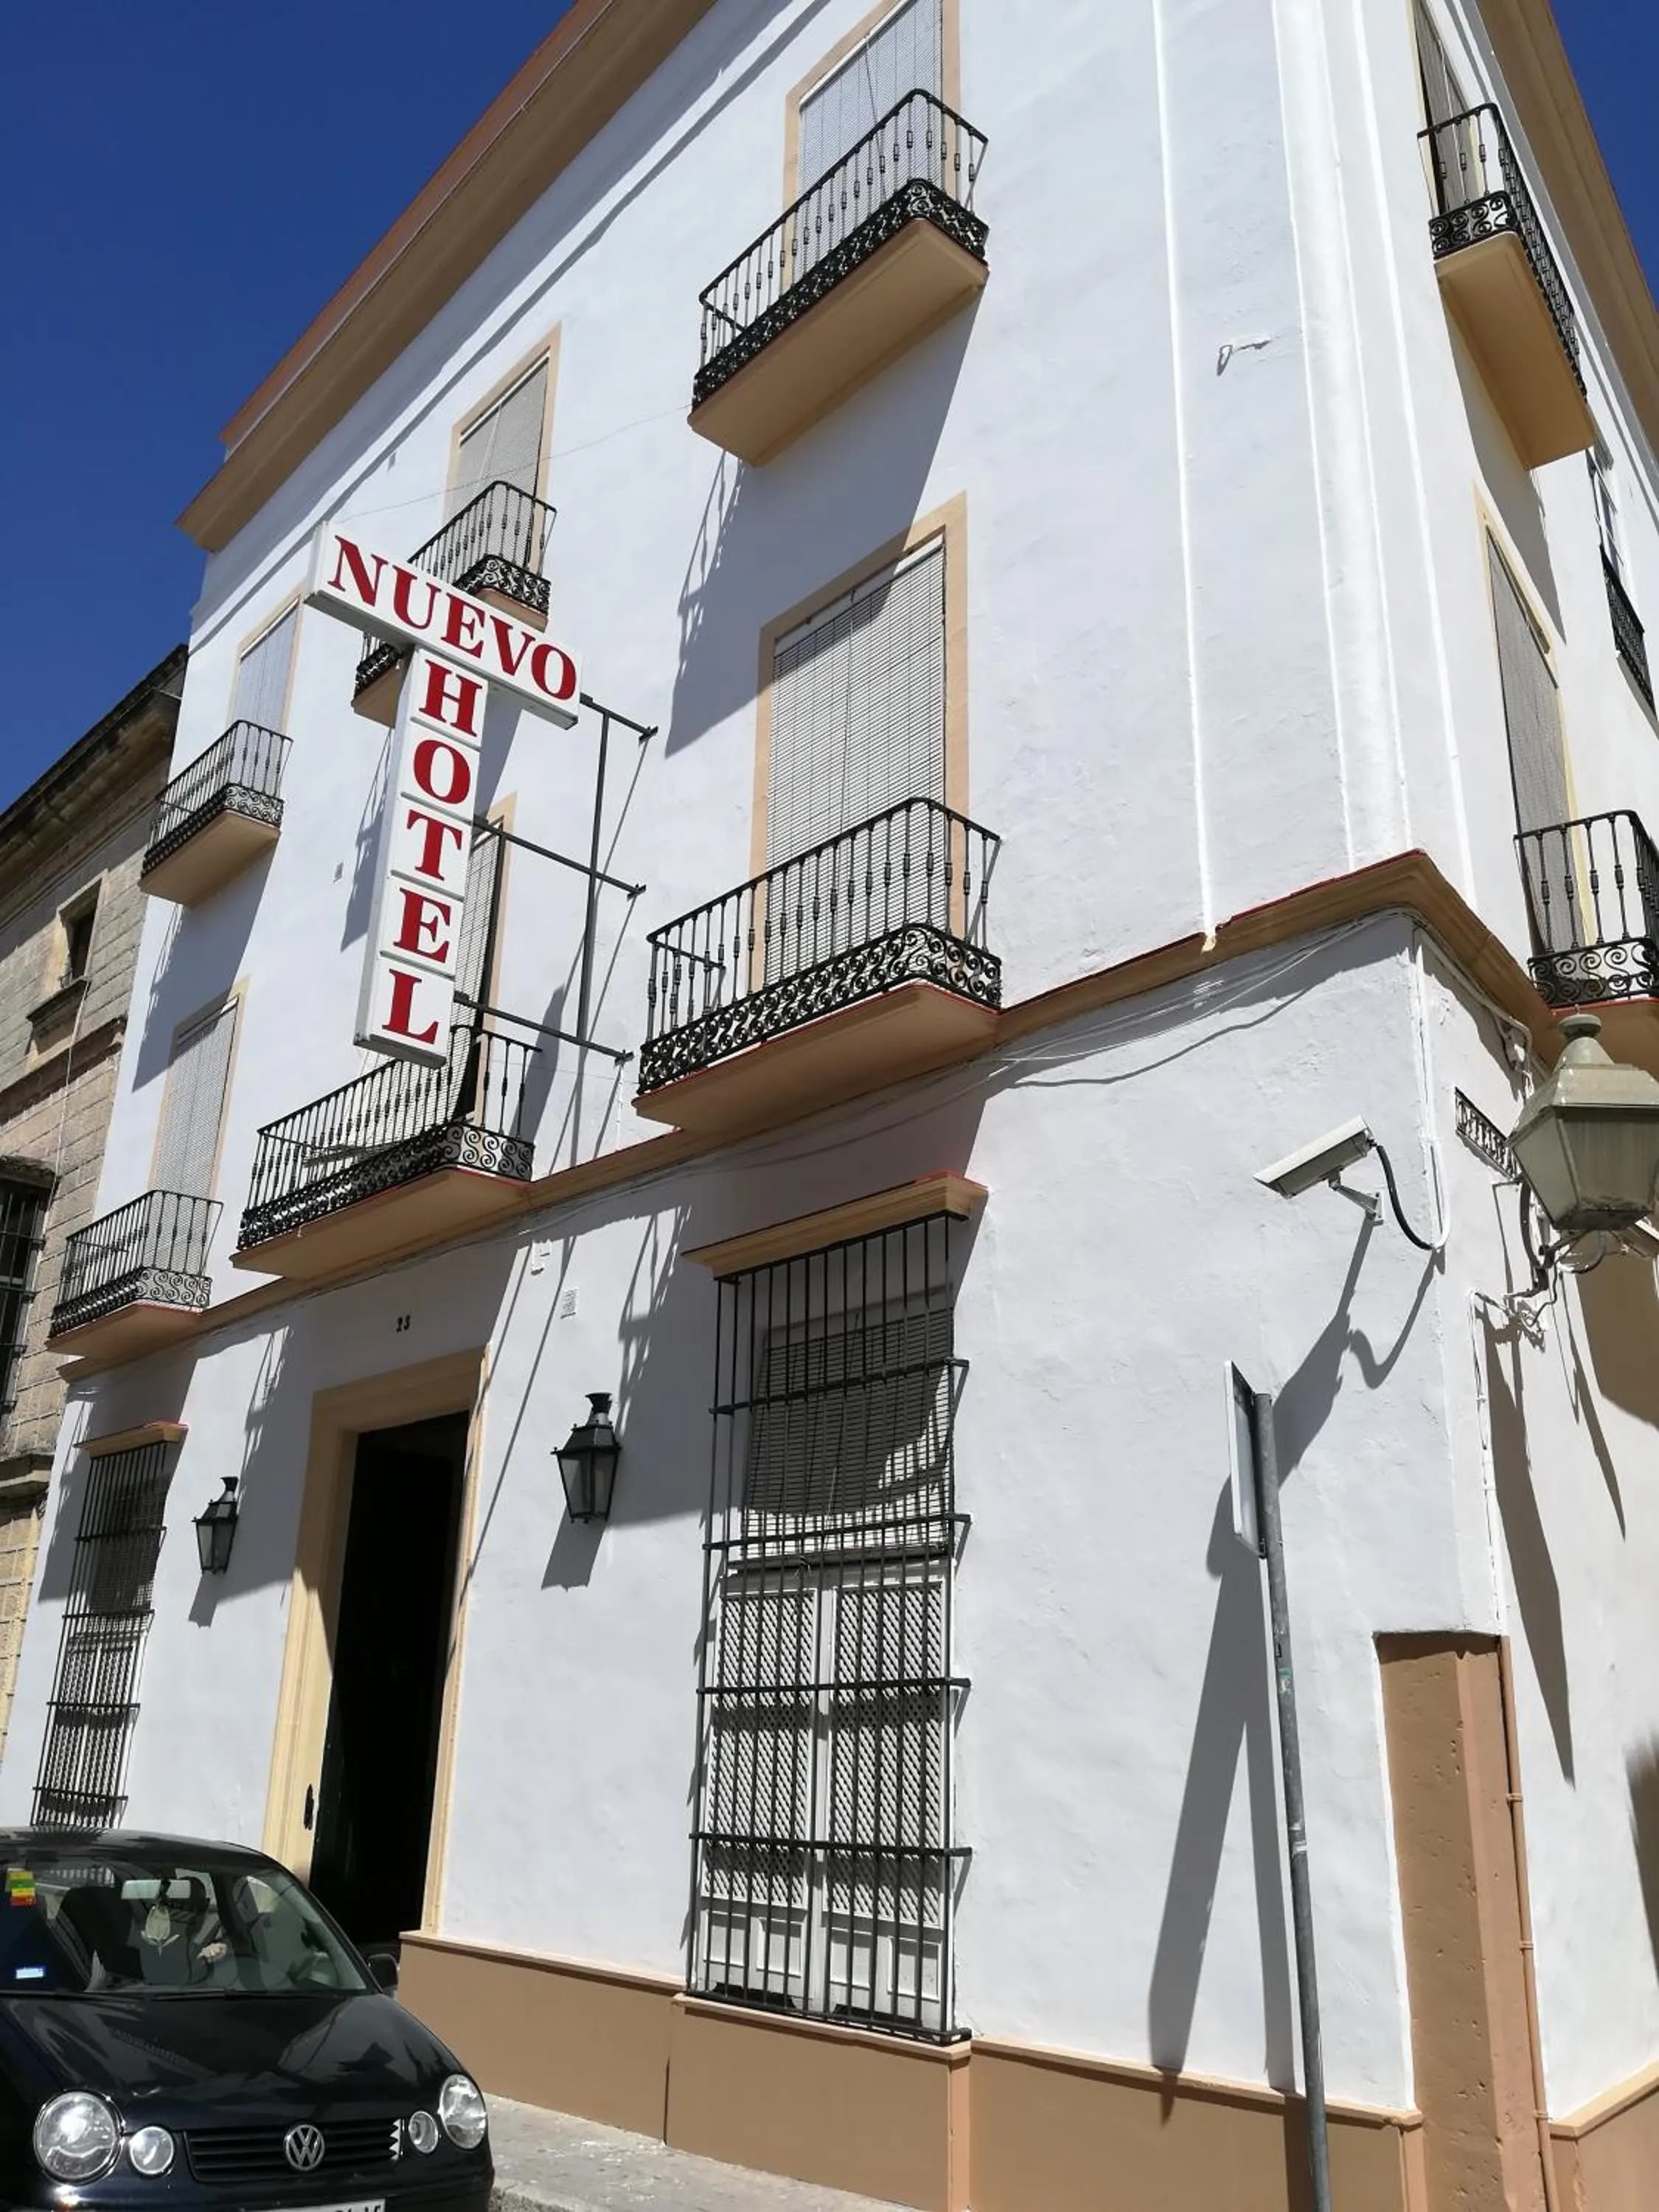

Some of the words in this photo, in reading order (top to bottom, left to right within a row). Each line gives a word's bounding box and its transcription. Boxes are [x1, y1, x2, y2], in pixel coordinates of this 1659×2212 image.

[328, 535, 578, 700] NUEVO
[382, 659, 484, 1045] HOTEL
[284, 2124, 325, 2171] VW
